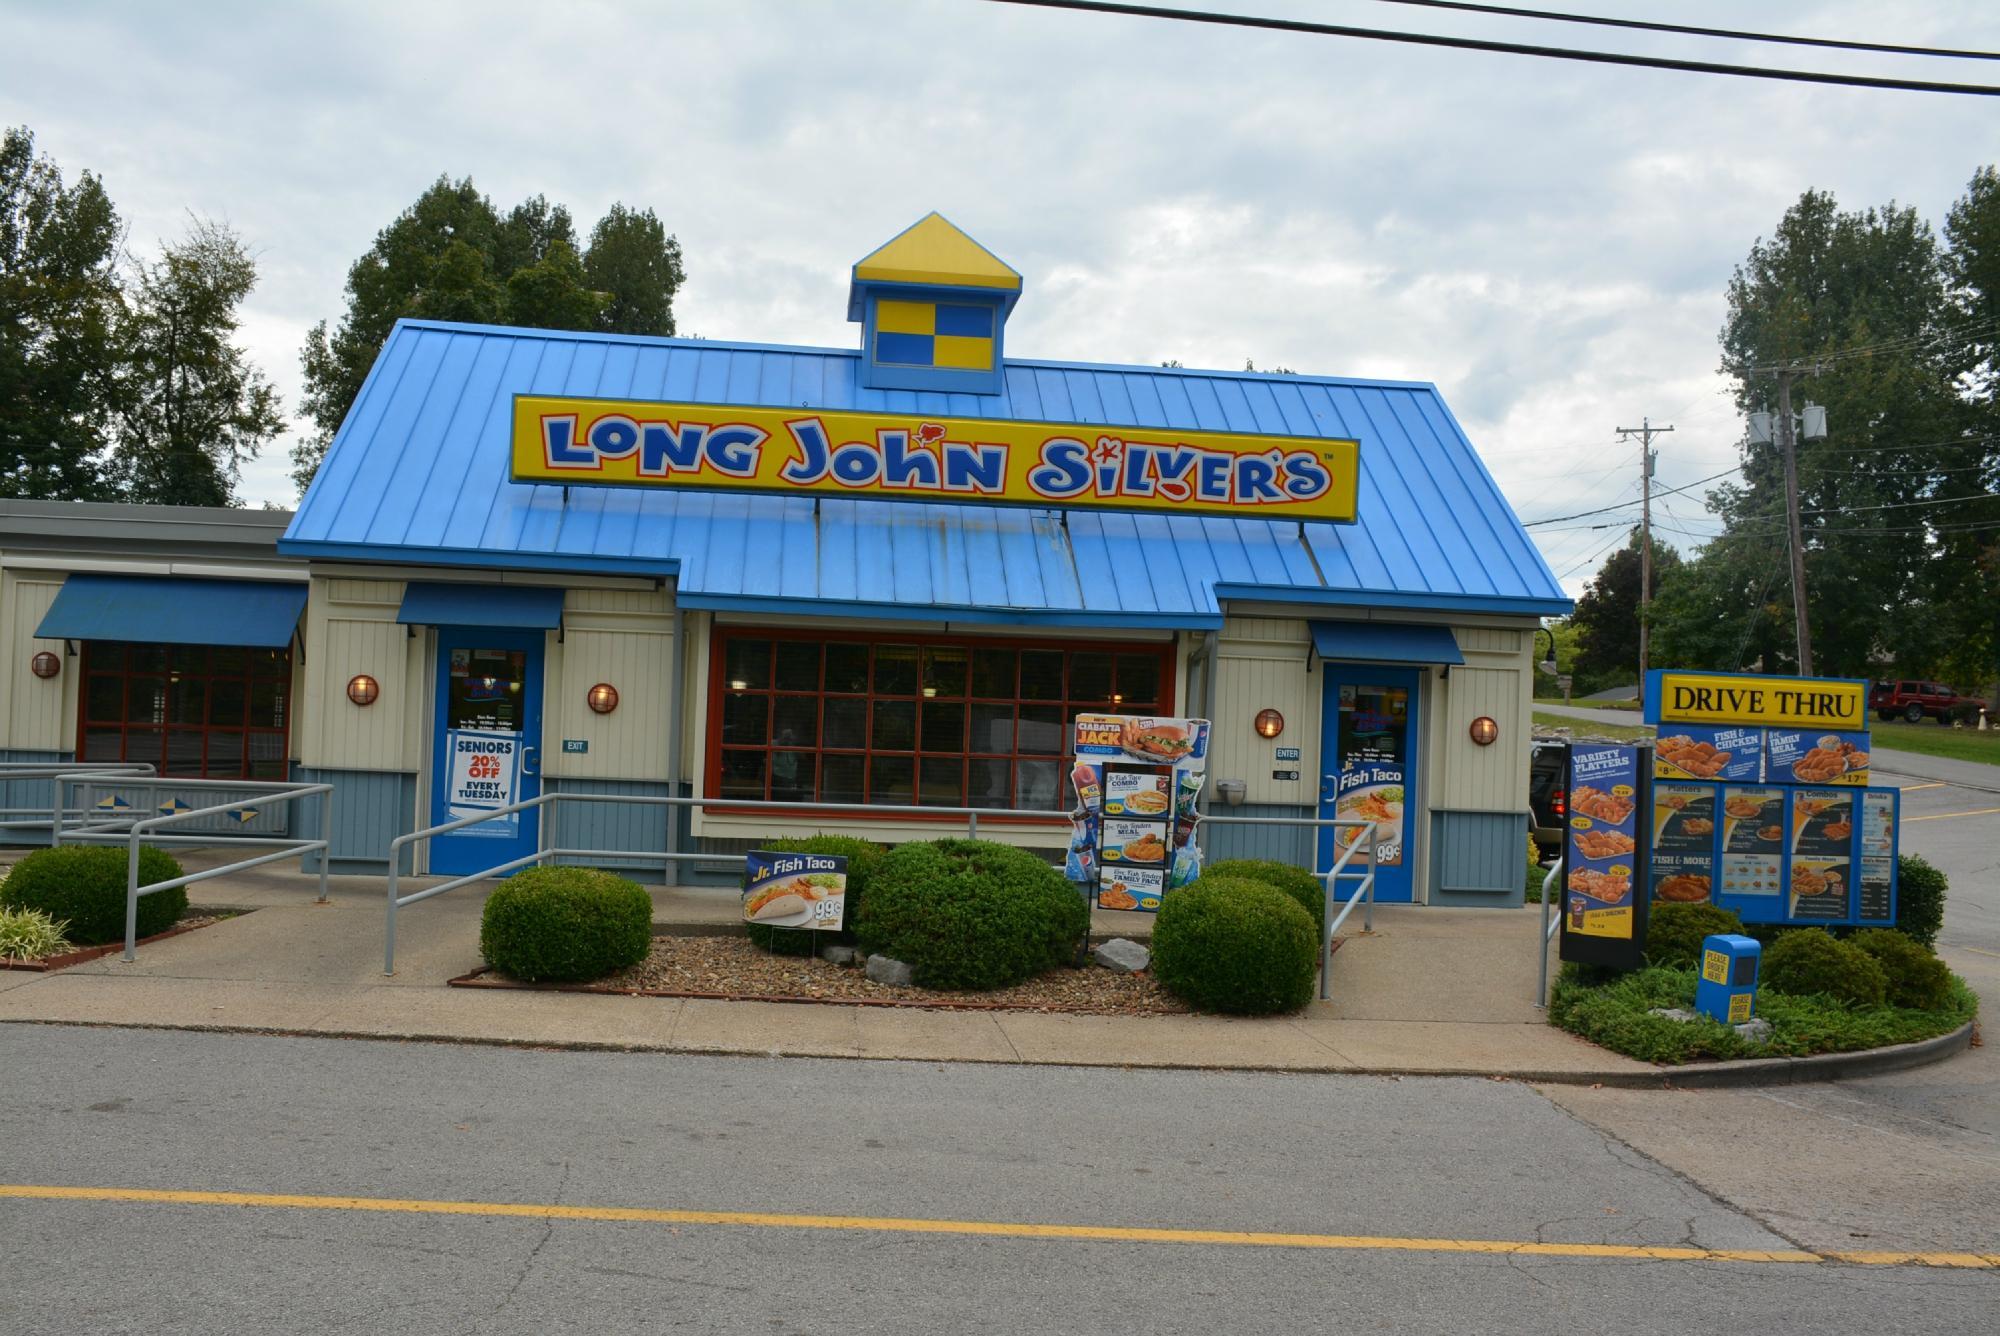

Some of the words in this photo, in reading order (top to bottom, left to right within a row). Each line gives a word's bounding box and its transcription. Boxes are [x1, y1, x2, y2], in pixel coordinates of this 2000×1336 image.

[541, 413, 772, 480] LONG
[1673, 686, 1764, 714] DRIVE
[1775, 691, 1856, 718] THRU
[1078, 722, 1120, 732] CIABATTA
[1078, 731, 1120, 746] JACK
[1714, 730, 1737, 742] FISH
[1770, 734, 1800, 748] FAMILY
[457, 741, 512, 754] SENIORS
[567, 741, 584, 750] EXIT
[1715, 735, 1758, 750] CHICKEN
[1772, 743, 1796, 754] MEAL
[1083, 746, 1114, 754] COMBO
[1277, 749, 1299, 758] ENTER
[470, 755, 501, 768] 20%
[1572, 749, 1620, 764] VARIETY
[1574, 756, 1630, 773] PLATTERS
[468, 767, 501, 779] OFF
[1340, 770, 1369, 791] Fish
[1371, 767, 1402, 781] Taco
[466, 781, 501, 791] EVERY
[1668, 785, 1702, 793] Platters
[458, 790, 507, 799] TUESDAY
[1806, 790, 1838, 799] Combos
[773, 857, 803, 875] Fish
[805, 856, 836, 870] Taco
[1652, 856, 1674, 865] FISH
[1683, 856, 1712, 865] MORE
[752, 865, 771, 882] Jr.
[1113, 874, 1141, 883] FAMILY
[1141, 877, 1161, 886] PACK
